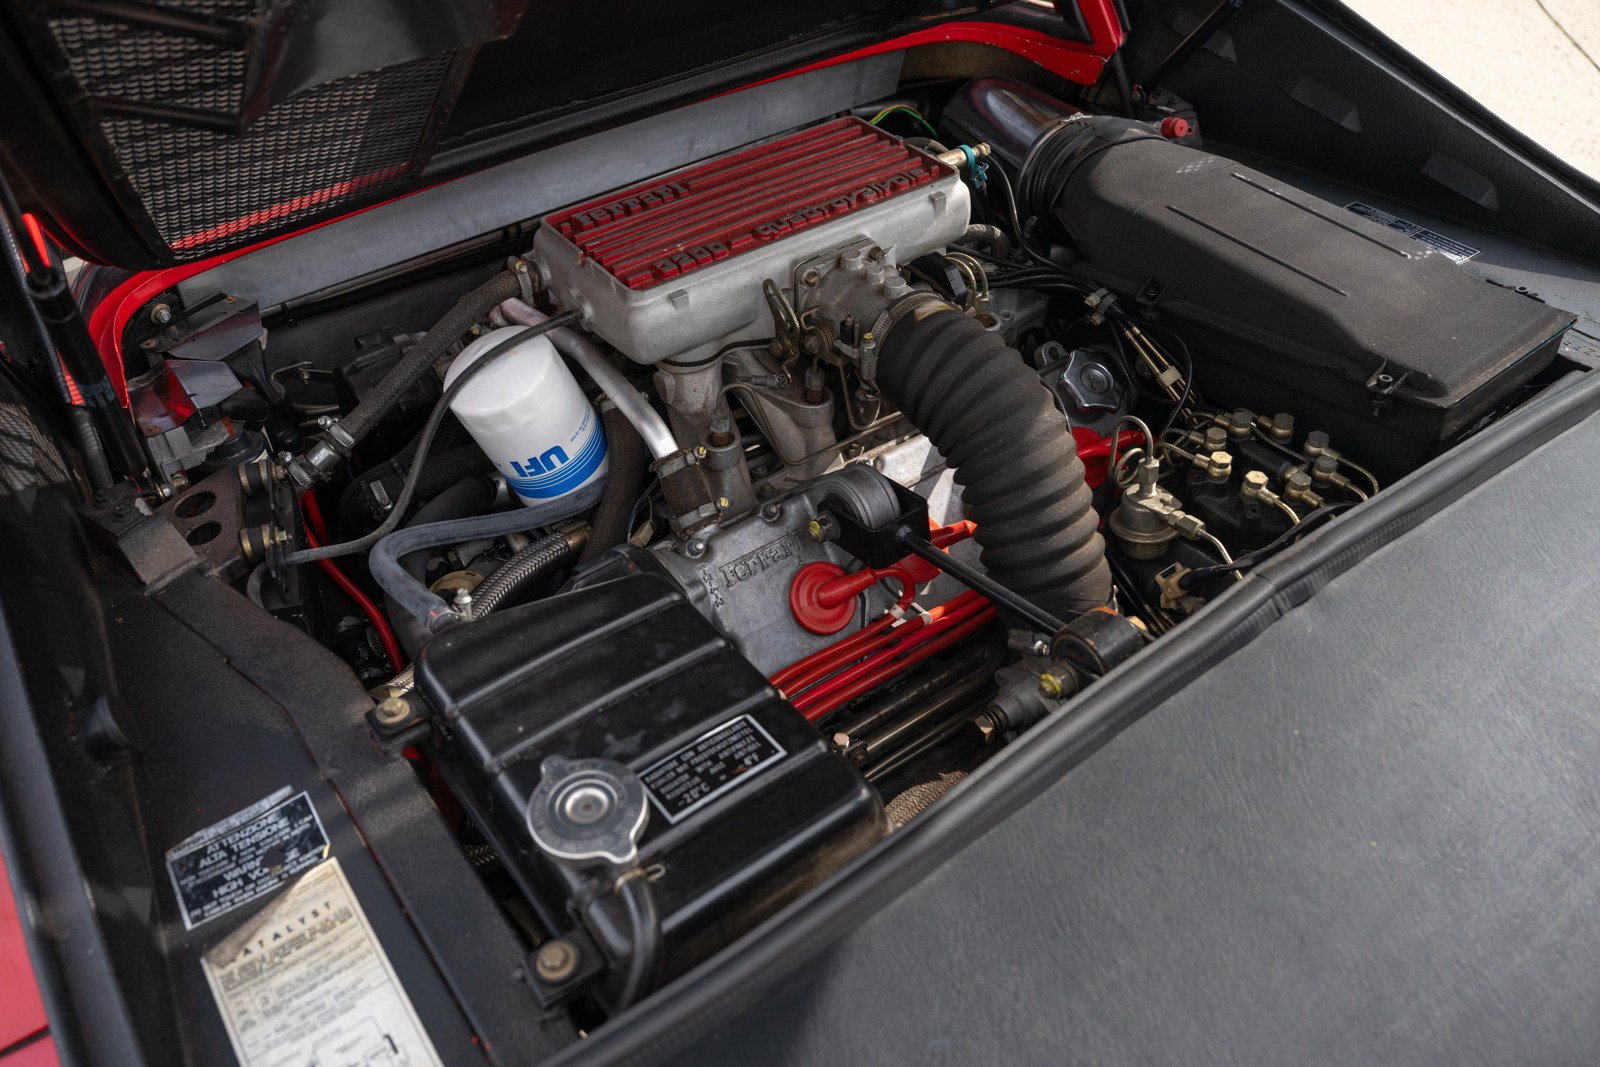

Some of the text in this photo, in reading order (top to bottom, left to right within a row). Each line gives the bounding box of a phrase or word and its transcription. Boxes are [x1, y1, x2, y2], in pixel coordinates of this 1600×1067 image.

[654, 240, 730, 277] 3200
[510, 445, 570, 478] UFI
[718, 528, 802, 588] Ferrari
[197, 847, 227, 869] ALTA
[229, 816, 290, 854] TENSIONE
[205, 811, 279, 856] ATTENZIONE
[211, 875, 244, 900] HIGH
[229, 901, 332, 963] ATALYST
